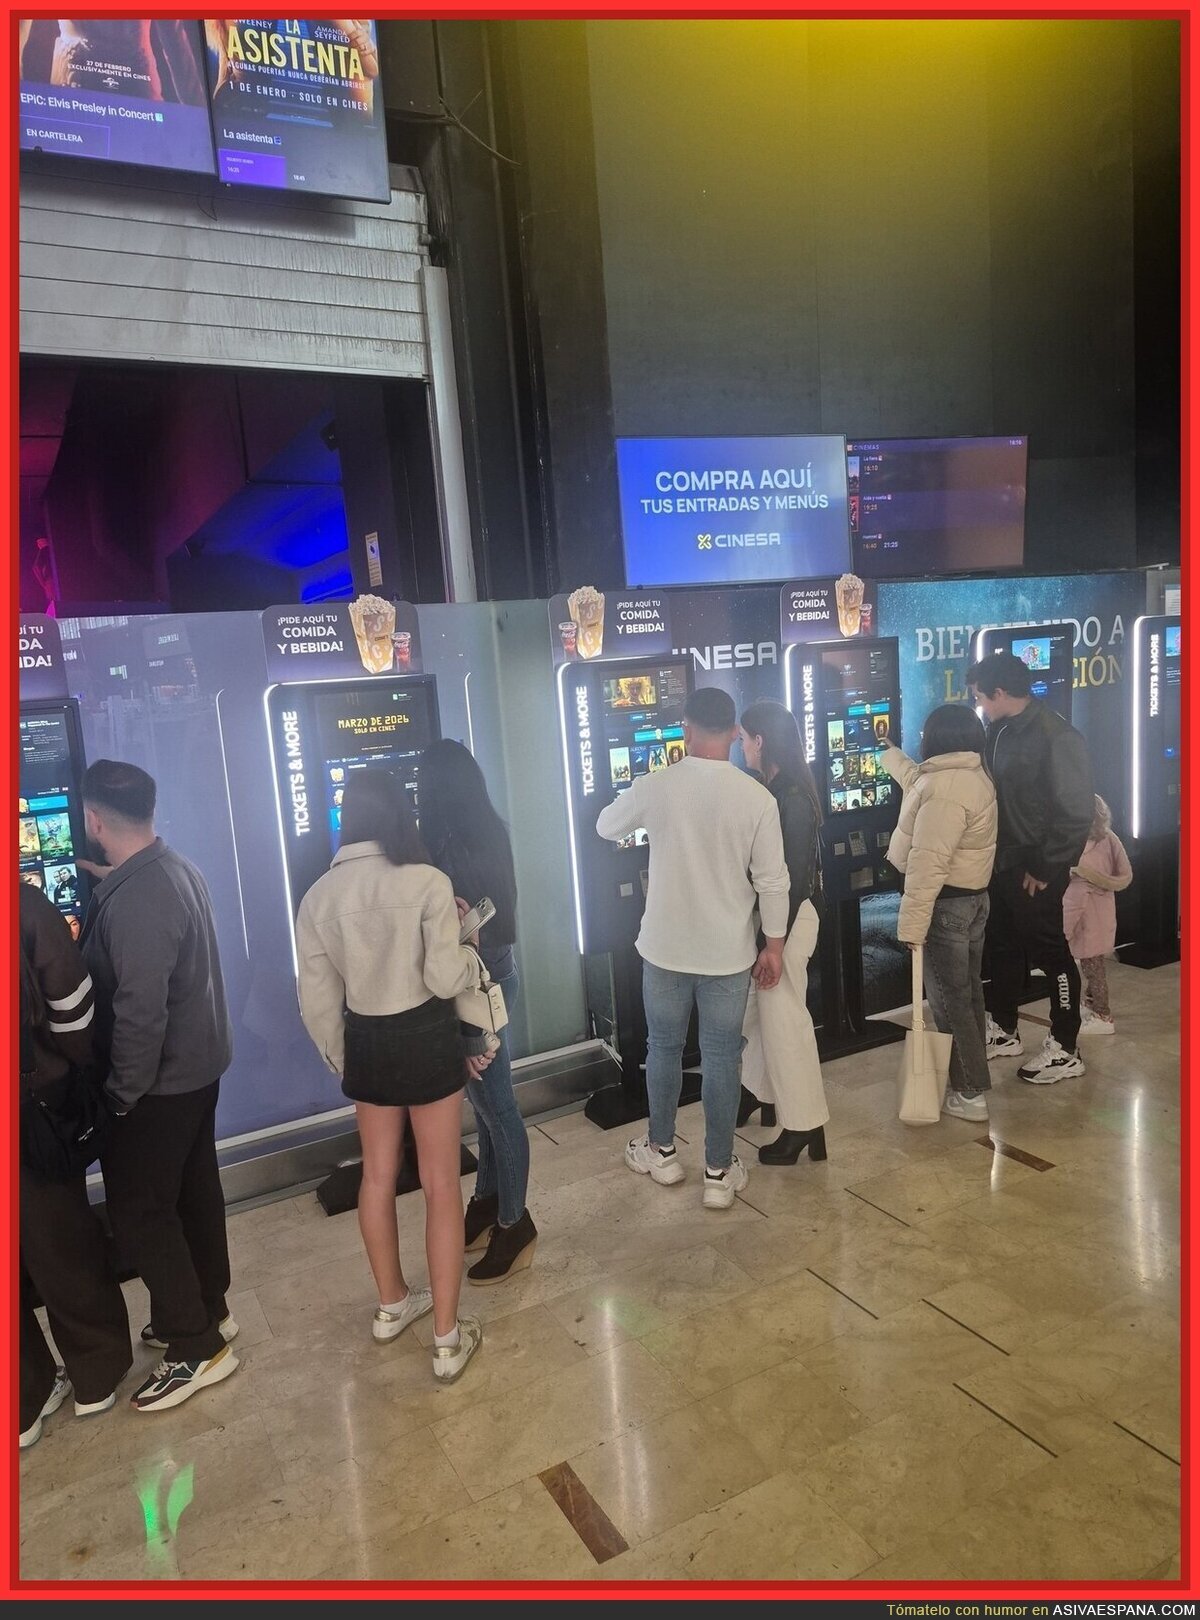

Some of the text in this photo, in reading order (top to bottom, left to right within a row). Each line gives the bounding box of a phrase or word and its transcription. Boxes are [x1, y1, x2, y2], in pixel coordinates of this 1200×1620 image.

[285, 19, 301, 35] LA
[316, 25, 347, 36] AMANDA
[314, 30, 350, 44] SEYFRIED
[227, 25, 365, 81] ASISTENTA
[68, 63, 122, 77] EXCLUSIVAMENTE
[133, 73, 151, 81] CINES
[104, 63, 132, 72] FEBRERO
[258, 66, 285, 77] PUERTAS
[288, 71, 308, 81] NUNCA
[229, 80, 368, 111] 1 DE ENERO SOLO EN CINES
[48, 97, 70, 109] Elvis
[73, 101, 106, 116] Presley
[108, 105, 117, 116] in
[119, 107, 154, 121] Concert
[27, 129, 83, 143] EN CARTELERA
[223, 128, 273, 144] La asistenta
[655, 462, 812, 492] COMPRA AQUÍ
[642, 490, 829, 514] TUS ENTRADAS Y MENÚS
[715, 532, 781, 548] CINESA
[805, 589, 820, 597] AQUÍ
[635, 599, 651, 609] AQUÍ
[792, 599, 826, 609] COMIDA
[278, 614, 338, 626] ¡PIDE AQUÍ TU
[620, 609, 660, 620] COMIDA
[789, 611, 830, 622] Y BEBIDA!
[28, 626, 44, 634] TU
[282, 626, 337, 639] COMIDA
[616, 622, 665, 634] Y BEBIDA!
[1108, 615, 1125, 645] A
[19, 638, 43, 651] DA
[277, 641, 344, 655] Y BEBIDA!
[1150, 633, 1159, 664] MORE
[672, 641, 777, 671] NESA
[1150, 674, 1159, 717] TICKETS
[338, 715, 409, 728] MARZO DE 2026
[803, 664, 816, 764] TICKETS & MORE
[576, 685, 594, 796] TICKETS & MORE
[282, 710, 310, 837] TICKETS & MORE
